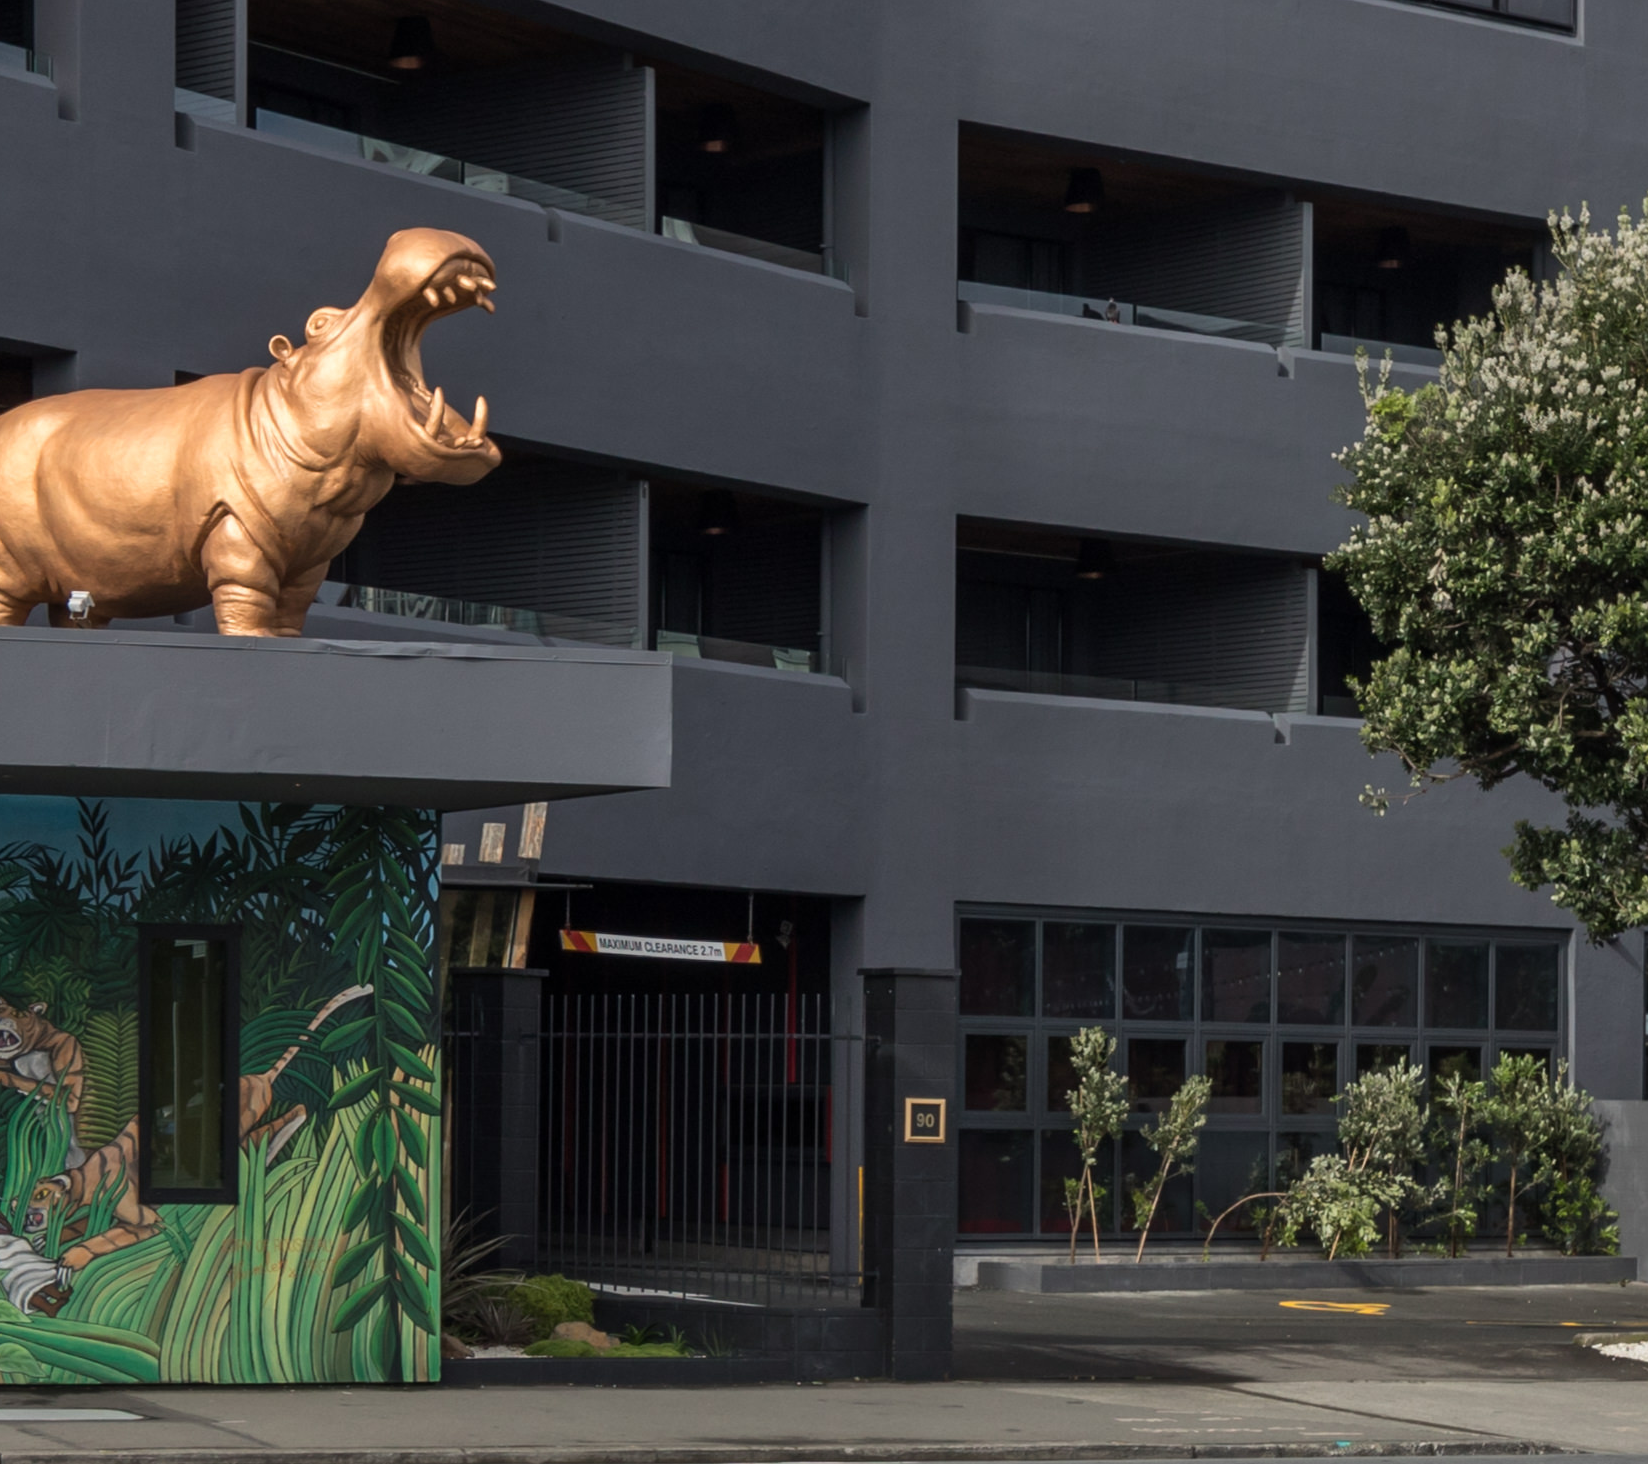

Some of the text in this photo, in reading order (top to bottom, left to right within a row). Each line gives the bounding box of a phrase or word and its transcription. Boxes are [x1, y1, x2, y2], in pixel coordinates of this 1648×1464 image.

[599, 937, 722, 957] MAXIMUM CLEARANCE 2.7m
[916, 1112, 935, 1128] 90
